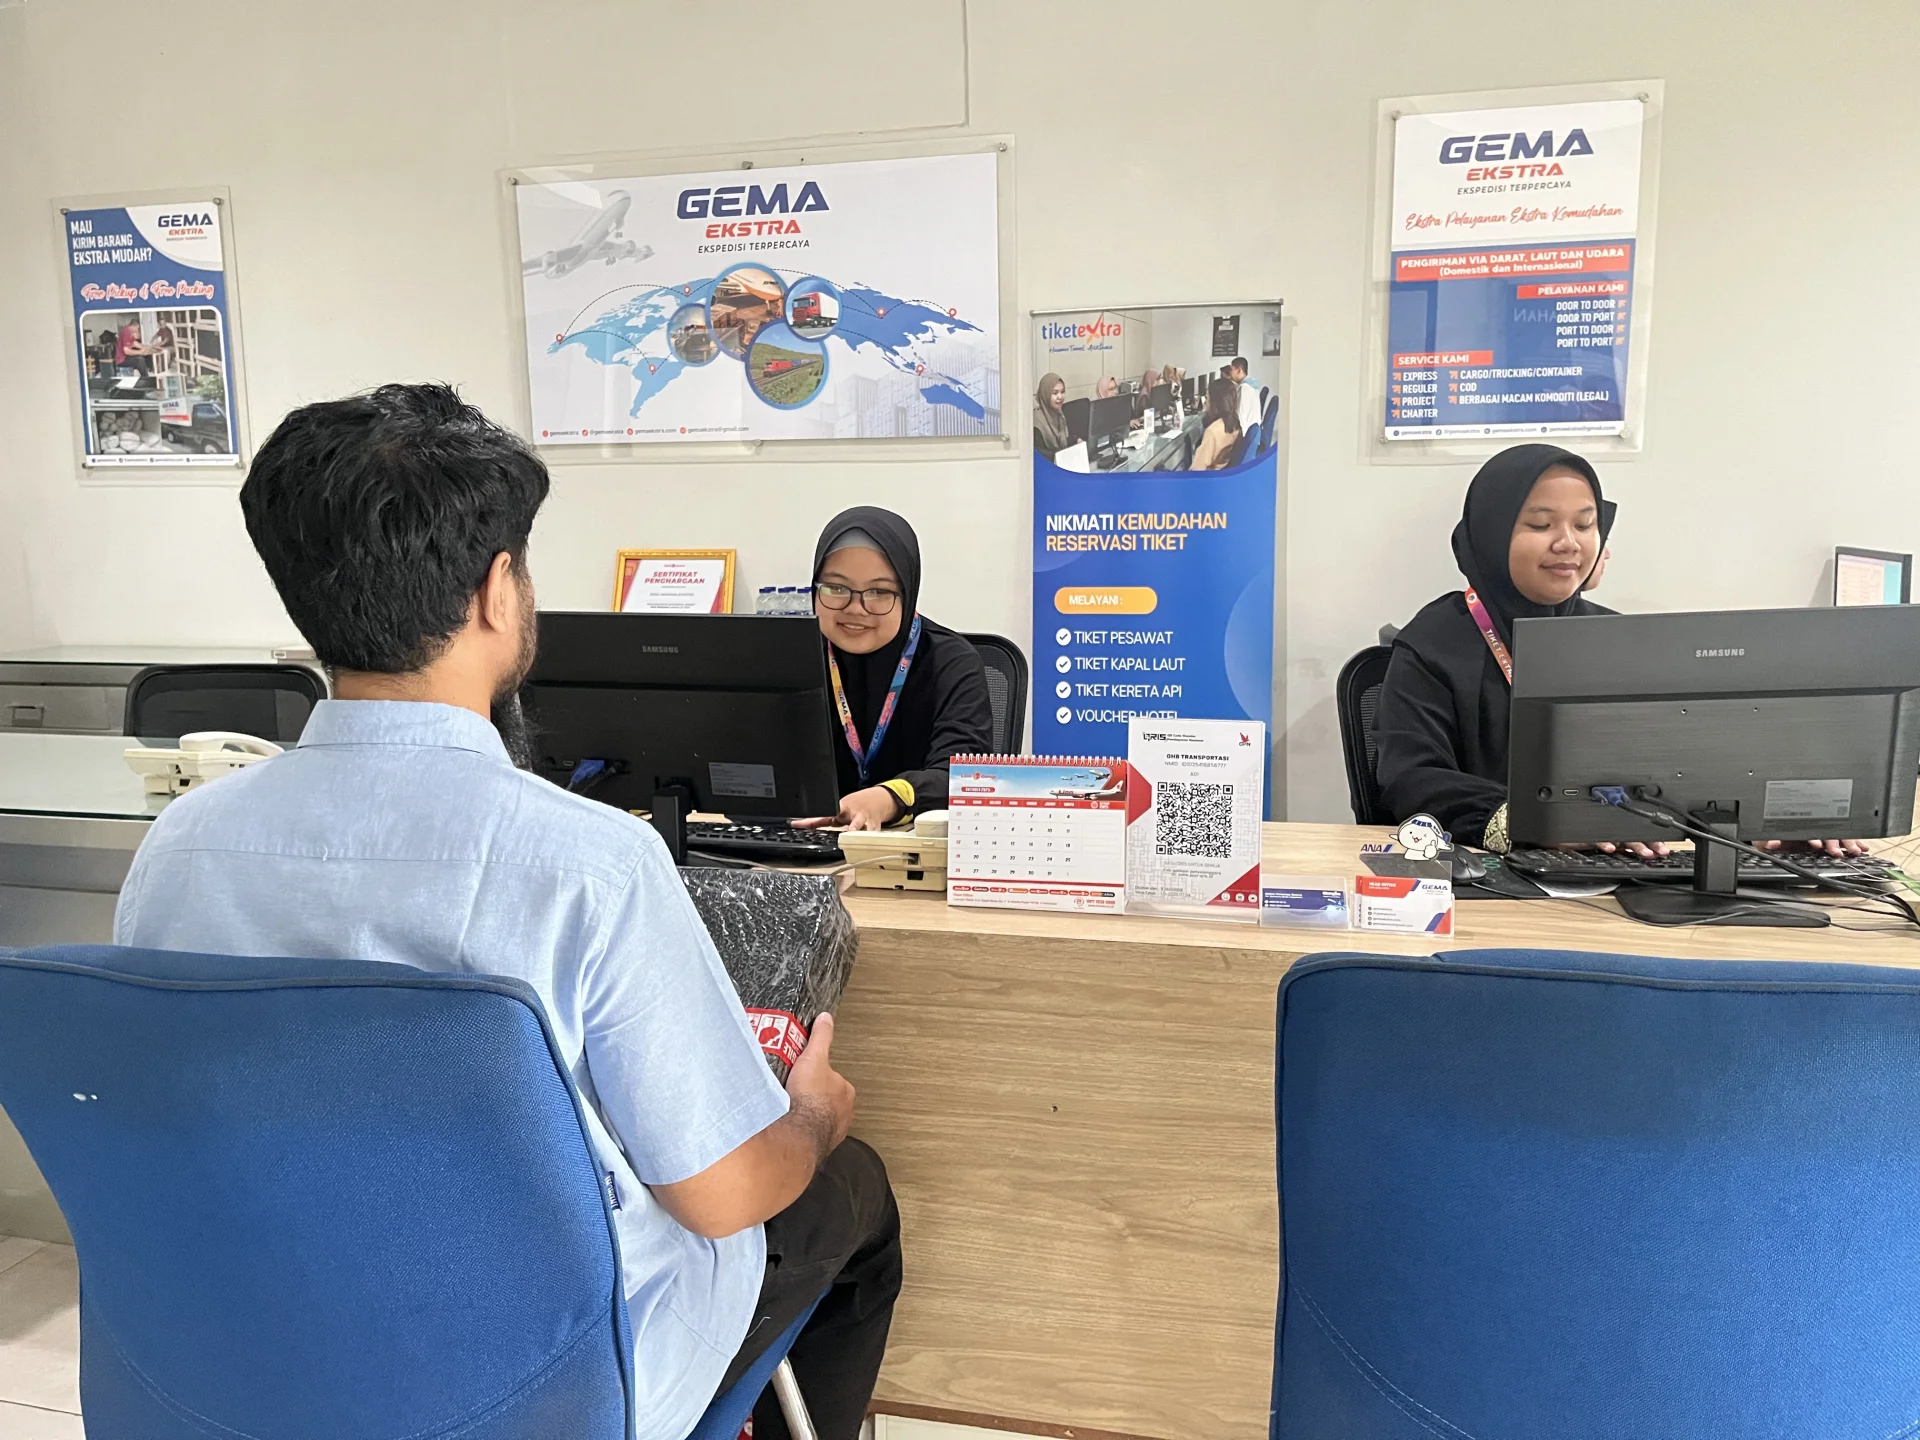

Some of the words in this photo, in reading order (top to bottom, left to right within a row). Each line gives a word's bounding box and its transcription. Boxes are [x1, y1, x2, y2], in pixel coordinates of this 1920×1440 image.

[1439, 128, 1594, 164] GEMA
[1466, 163, 1564, 181] EKSTRA
[1457, 185, 1506, 195] EKSPEDISI
[1510, 181, 1572, 192] TERPERCAYA
[677, 181, 830, 219] GEMA
[158, 213, 213, 227] GEMA
[1405, 213, 1441, 230] Ekstra
[1444, 211, 1507, 228] Pelayanan
[1509, 207, 1548, 223] Ekstra
[1552, 204, 1623, 222] Kemudahan
[71, 220, 92, 235] MAU
[169, 228, 204, 236] EKSTRA
[706, 219, 801, 238] EKSTRA
[72, 236, 96, 249] KIRIM
[97, 234, 133, 248] BARANG
[698, 243, 746, 253] EKSPEDISI
[750, 240, 810, 251] TERPERCAYA
[74, 250, 110, 265] EKSTRA
[111, 247, 152, 263] MUDAH?
[1401, 257, 1466, 268] PENGIRIMAN
[1468, 256, 1487, 265] VIA
[1530, 252, 1558, 261] LAUT
[1561, 251, 1584, 260] DAN
[1586, 248, 1624, 258] UDARA
[1439, 266, 1488, 277] (Domestik
[1491, 264, 1511, 272] dan
[1514, 259, 1583, 271] Internasional)
[81, 283, 106, 302] Free
[151, 280, 176, 299] Free
[1538, 285, 1595, 295] PELAYANAN
[1598, 284, 1624, 292] KAMI
[1556, 301, 1579, 311] DOOR
[1580, 300, 1591, 309] TO
[1593, 299, 1615, 309] DOOR
[1557, 313, 1580, 323] DOOR
[1581, 313, 1592, 322] TO
[1593, 312, 1615, 321] PORT
[1556, 326, 1578, 336] PORT
[1579, 325, 1590, 334] TO
[1591, 325, 1614, 334] DOOR
[1557, 338, 1578, 348] PORT
[1580, 338, 1590, 347] TO
[1592, 337, 1613, 346] PORT
[1398, 355, 1439, 365] SERVICE
[1442, 354, 1469, 364] KAMI
[1403, 371, 1438, 381] EXPRESS
[1460, 367, 1582, 379] CARGO/TRUCKING/CONTAINER
[1402, 384, 1438, 393] REGULER
[1459, 383, 1477, 392] COD
[1402, 396, 1436, 406] PROJECT
[1459, 395, 1500, 404] BERBAGAI
[1502, 393, 1533, 403] MACAM
[1535, 392, 1575, 403] KOMODITI
[1576, 391, 1608, 402] (LEGAL)
[1402, 408, 1438, 418] CHARTER
[1046, 514, 1113, 531] NIKMATI
[1117, 512, 1226, 530] KEMUDAHAN
[1046, 534, 1136, 551] RESERVASI
[1140, 533, 1187, 550] TIKET
[1069, 595, 1118, 605] MELAYANI
[1074, 631, 1108, 644] TIKET
[1110, 631, 1173, 644] PESAWAT
[1486, 628, 1502, 651] TIKET
[642, 645, 679, 653] SAMSUNG
[1695, 648, 1745, 657] SAMSUNG
[1074, 657, 1108, 670] TIKET
[1111, 658, 1150, 670] KAPAL
[1153, 658, 1186, 670] LAUT
[1075, 684, 1109, 697] TIKET
[1111, 684, 1159, 697] KERETA
[1161, 685, 1182, 697] API
[1361, 844, 1382, 852] ANA
[783, 1041, 798, 1064] GILE
